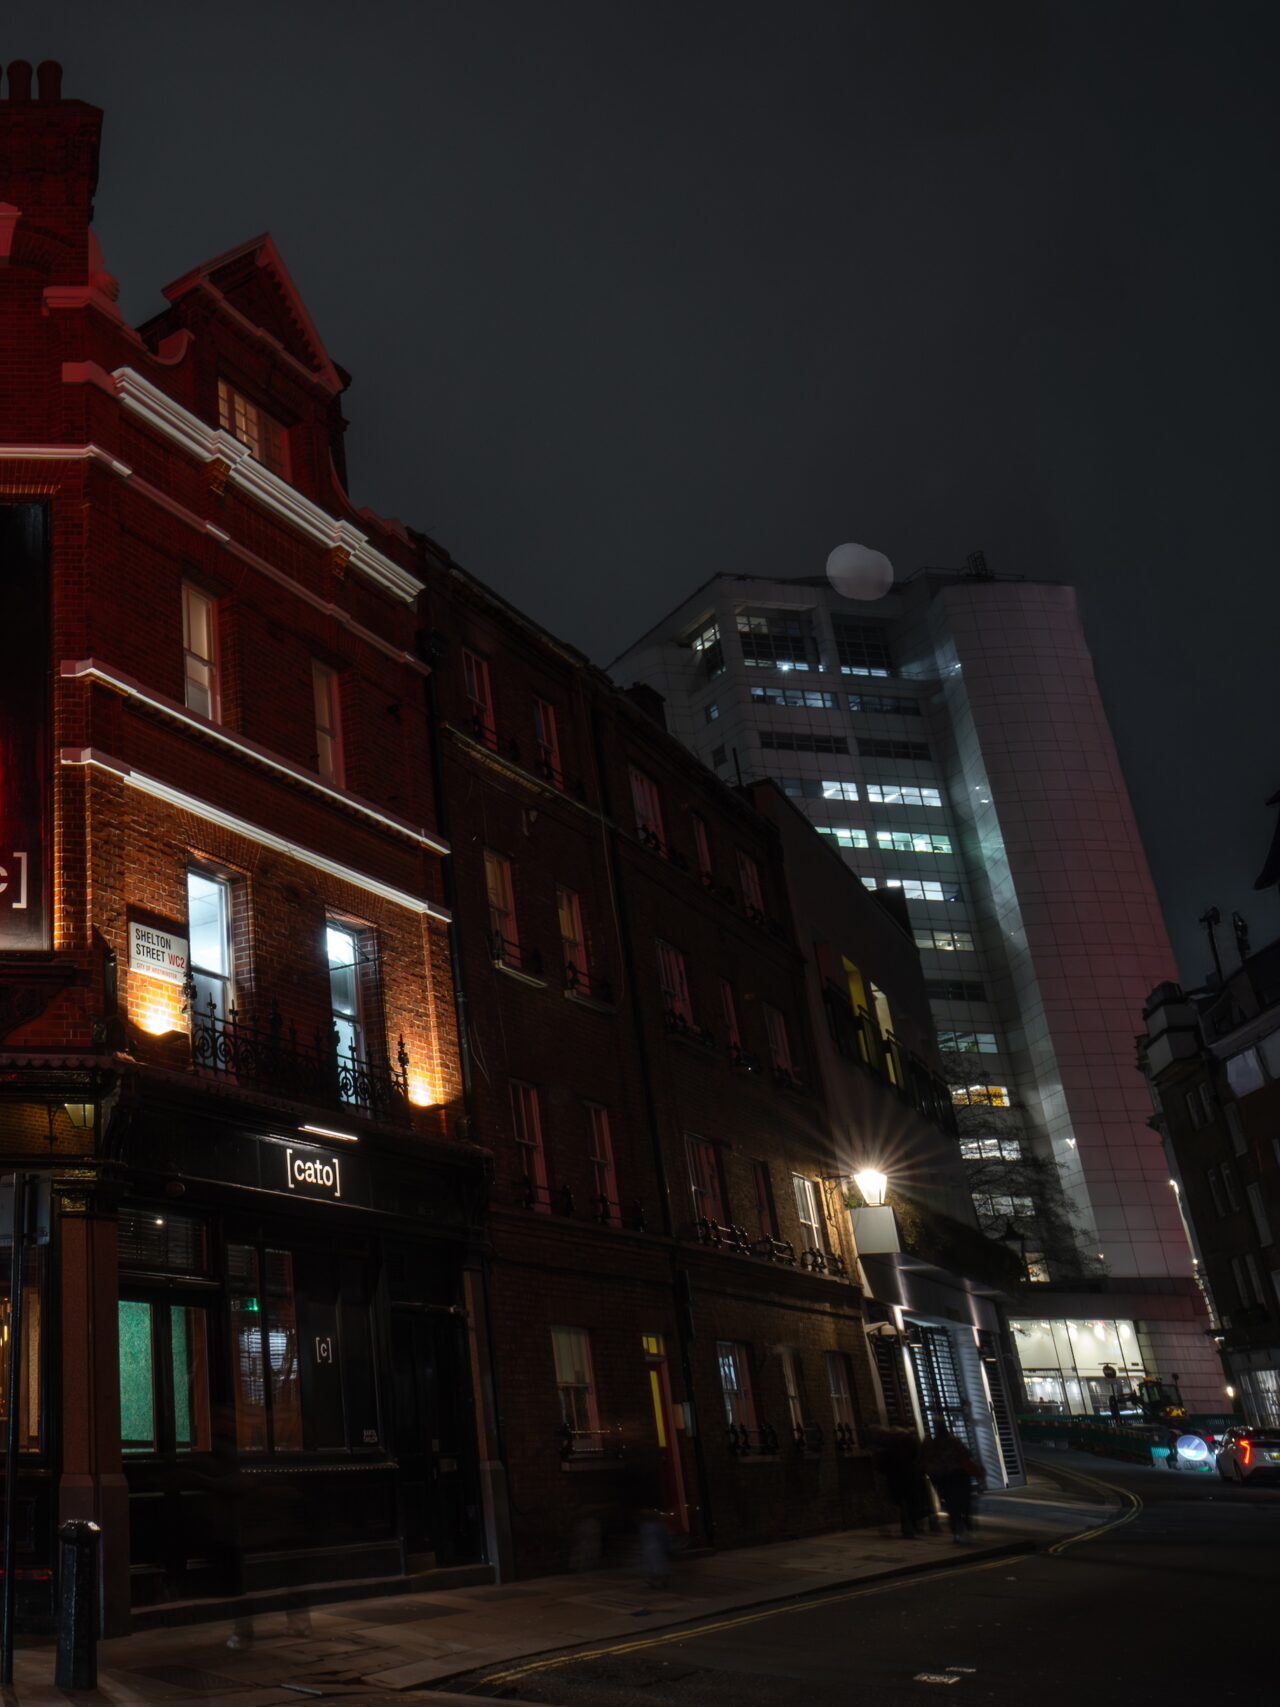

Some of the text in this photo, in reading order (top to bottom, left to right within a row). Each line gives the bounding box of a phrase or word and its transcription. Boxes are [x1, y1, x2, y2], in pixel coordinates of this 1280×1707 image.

[135, 928, 171, 950] SHELTON
[135, 943, 185, 969] STREET WC2
[286, 1149, 341, 1197] [cato]
